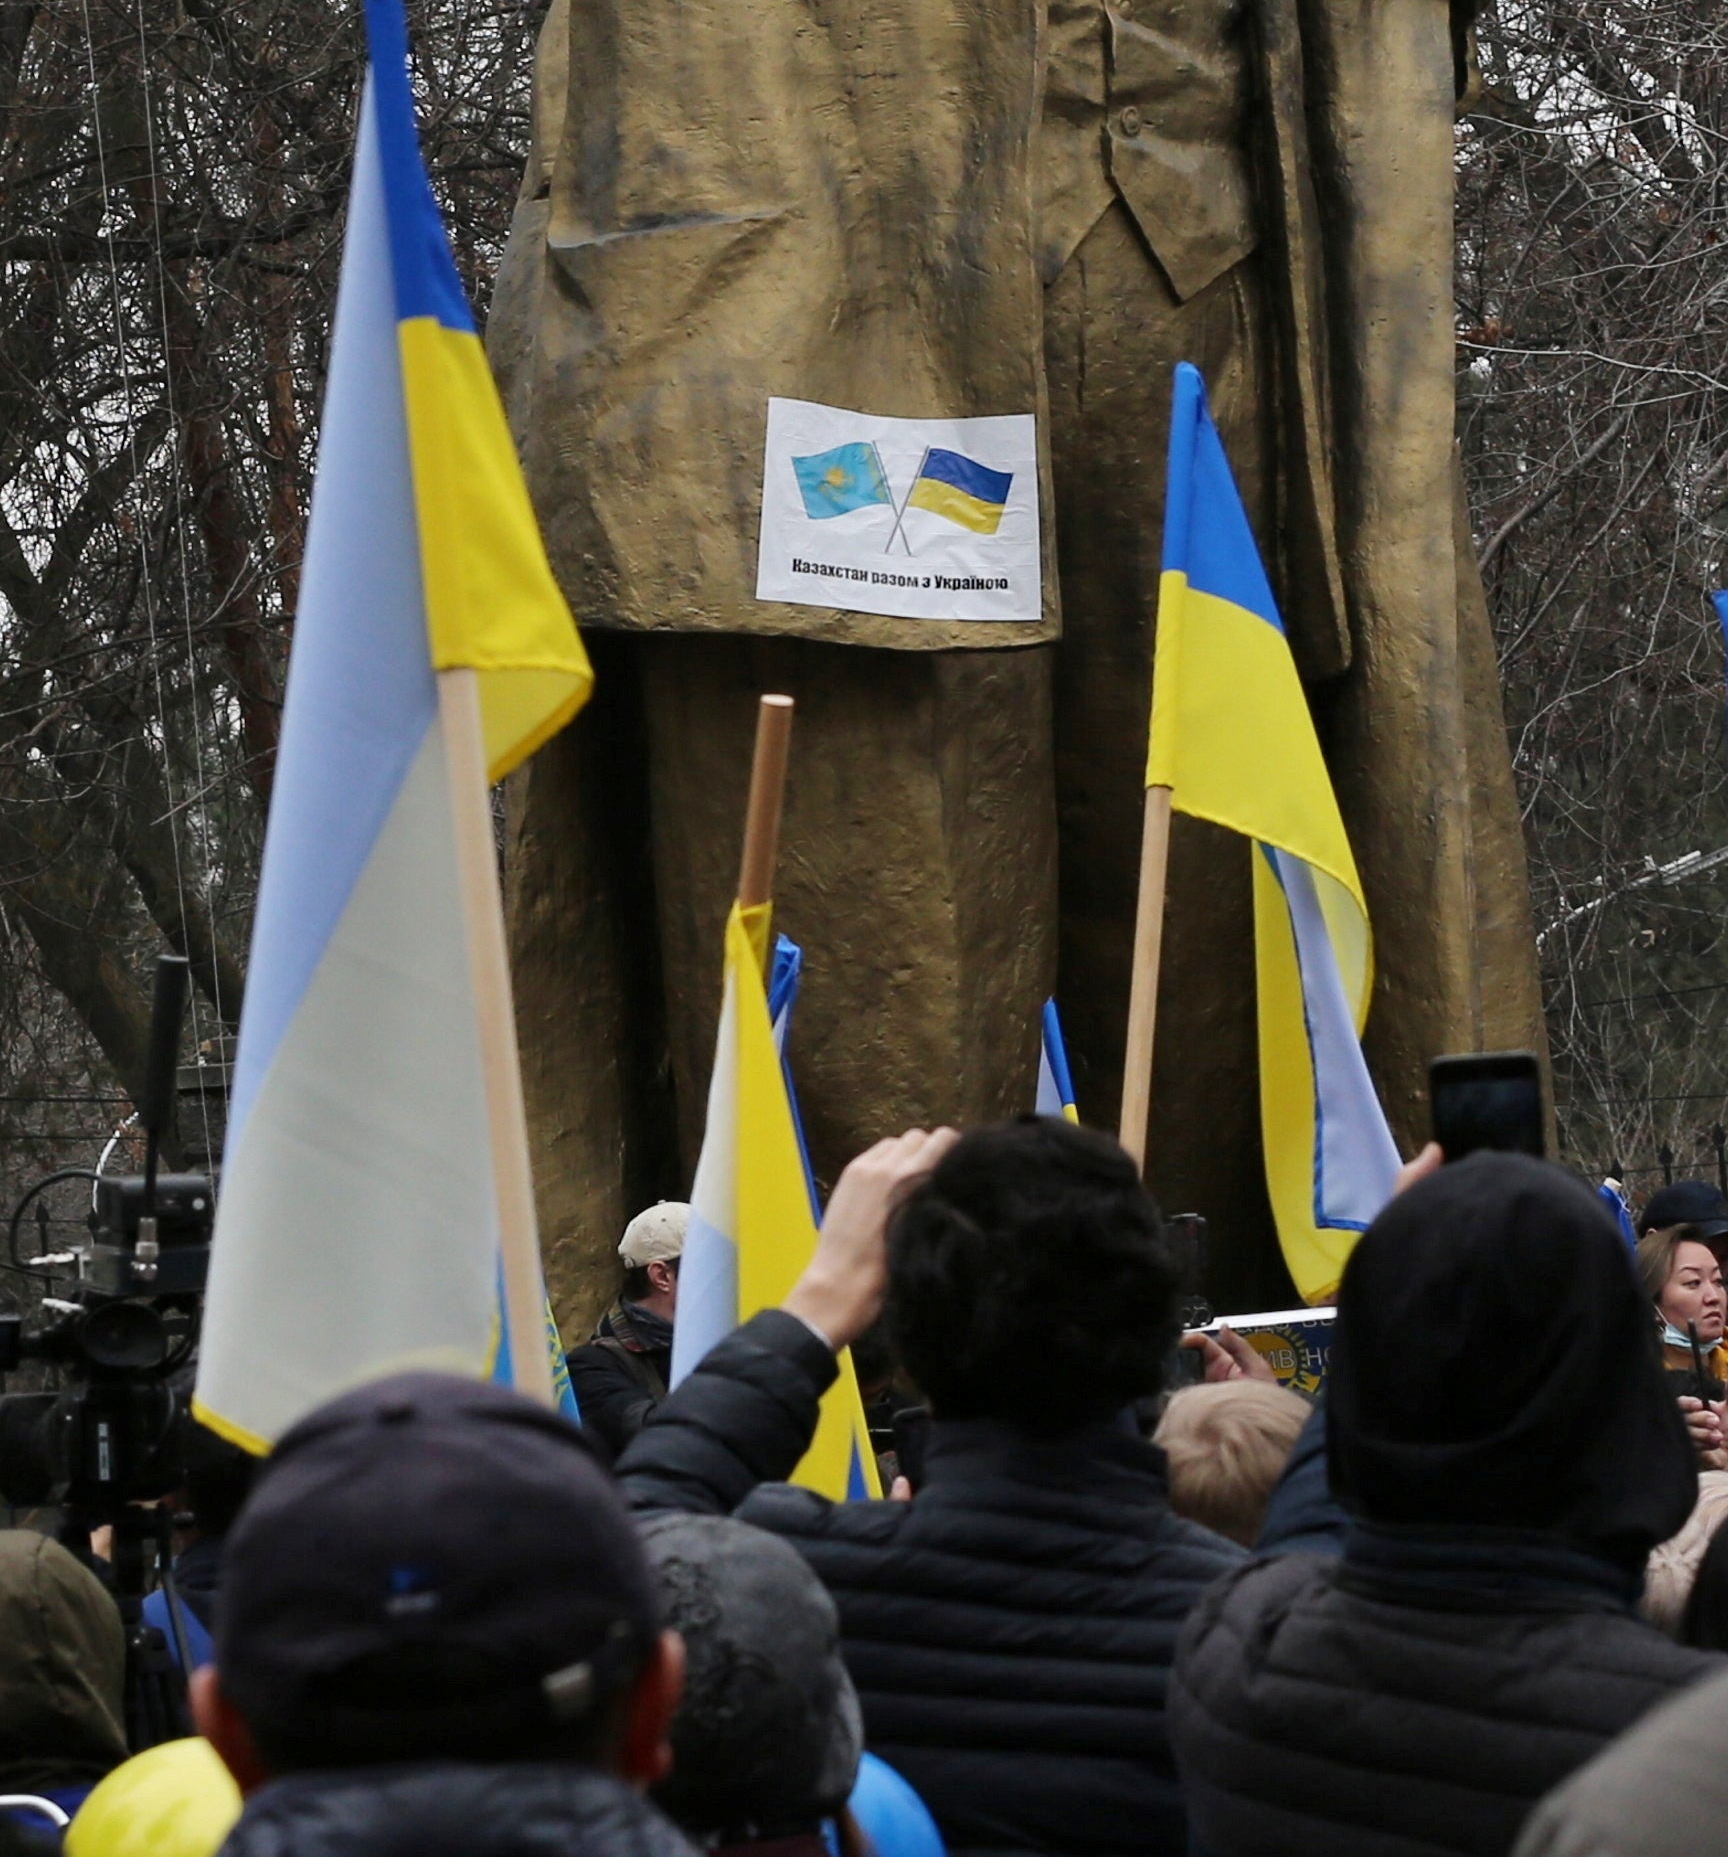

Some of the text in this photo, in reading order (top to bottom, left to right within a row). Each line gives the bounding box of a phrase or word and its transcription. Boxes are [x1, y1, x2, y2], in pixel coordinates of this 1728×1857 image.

[791, 557, 1010, 591] Казахстан разом з Україною
